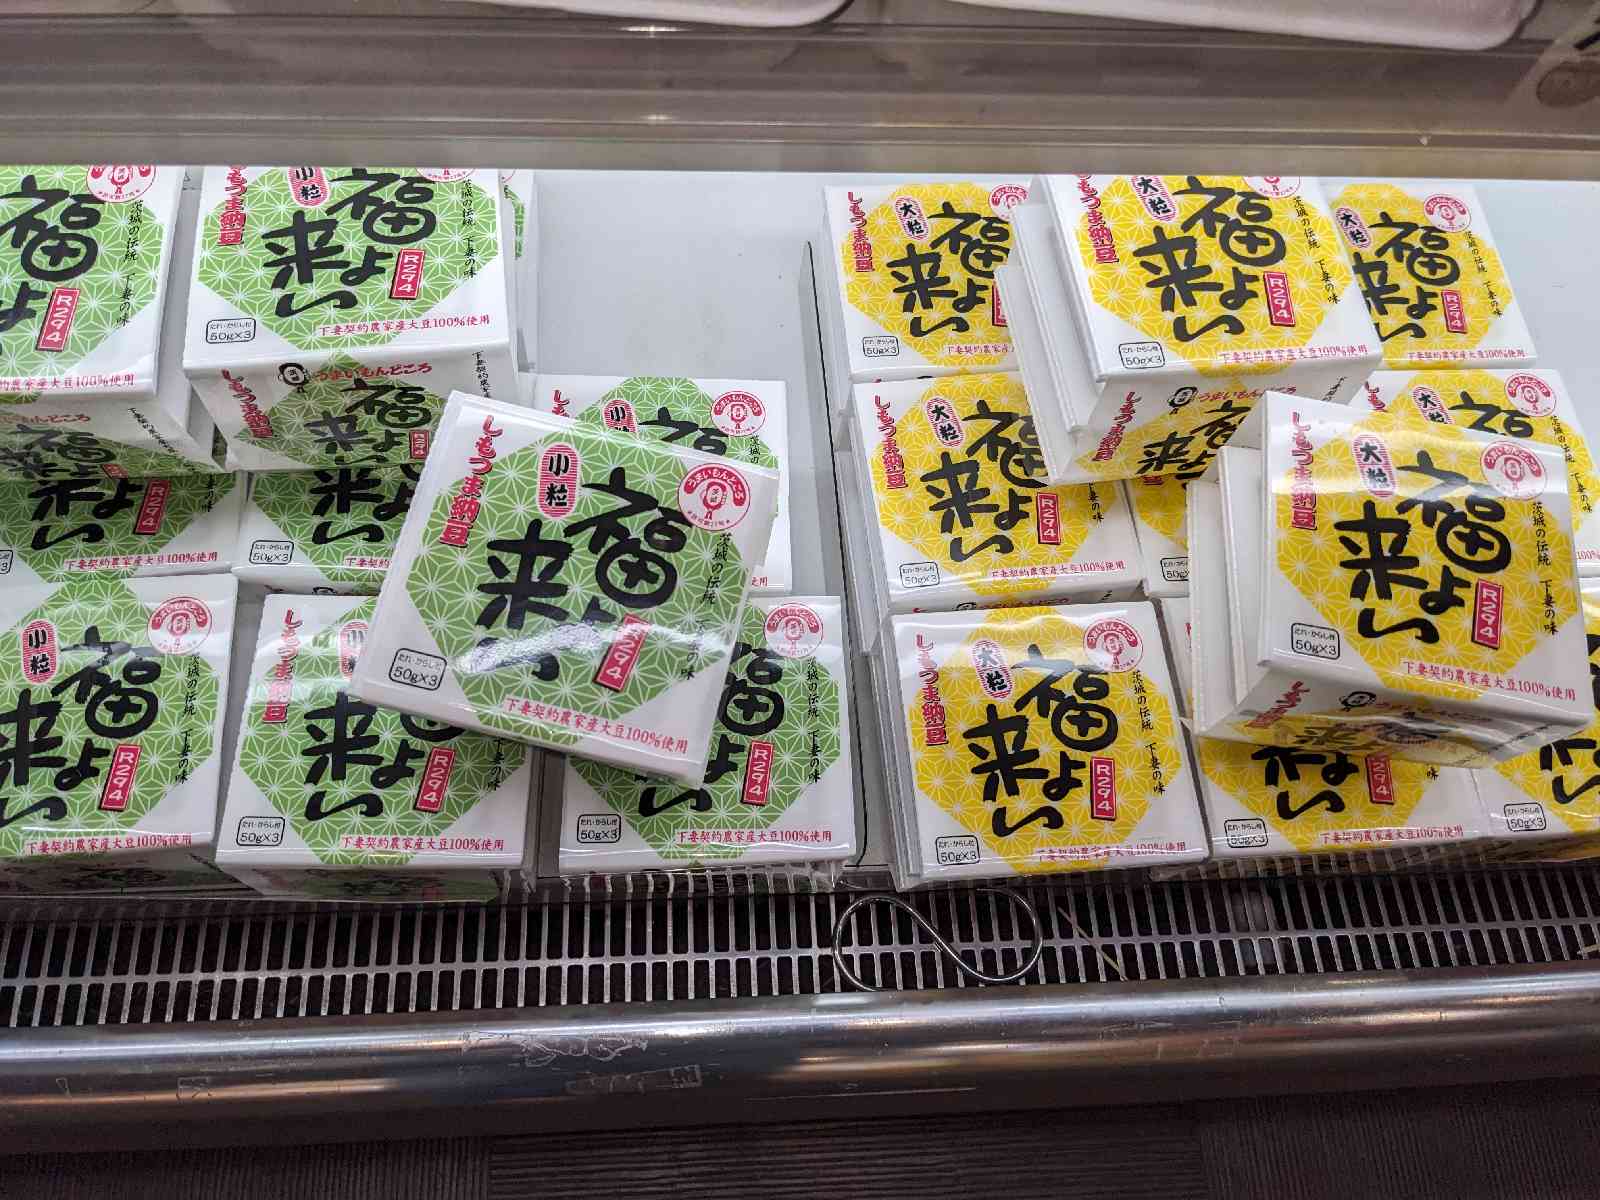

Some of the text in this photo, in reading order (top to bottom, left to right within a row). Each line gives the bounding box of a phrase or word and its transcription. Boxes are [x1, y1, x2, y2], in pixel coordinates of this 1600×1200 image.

[295, 167, 322, 200] 小粒
[1137, 178, 1171, 216] 大粒
[900, 202, 925, 236] 大粒
[1078, 174, 1119, 264] もつま納豆
[1340, 213, 1368, 245] 大粒
[398, 255, 420, 295] R294
[1268, 277, 1290, 320] R294
[46, 295, 73, 344] R294
[318, 315, 490, 337] 下妻契約農家産大豆100%使用
[930, 405, 959, 442] 大粒
[440, 415, 504, 548] しもつま納豆
[545, 453, 570, 508] 小粒
[1360, 442, 1390, 489] 大粒
[1042, 497, 1058, 538] R294
[699, 532, 734, 606] 茨城の伝統
[1333, 450, 1512, 645] 福よ来い
[1533, 502, 1559, 635] 茨城の伝統 下妻の味
[1480, 587, 1498, 639] R294
[28, 629, 51, 675] 小粒
[975, 648, 1008, 692] 大粒
[1404, 661, 1576, 701] 下妻契約農家産大豆100%使用
[506, 699, 690, 753] 下妻契約農家産大豆100%使用
[806, 658, 822, 784] 茨城の伝統 下妻の味
[963, 644, 1119, 837] 福よ来い
[1131, 669, 1166, 795] 茨城の伝統 下妻の味
[108, 751, 137, 802] R294
[174, 729, 194, 785] 下妻の味
[424, 757, 449, 804] R294
[749, 749, 770, 798] R294
[1371, 759, 1391, 797] 294
[1096, 763, 1113, 811] R294
[28, 834, 193, 857] 下妻契約農家産大豆100%使用
[341, 835, 504, 851] 下妻契約農家産大豆100%使用
[677, 831, 832, 845] 下妻契約農家産大豆100%使用
